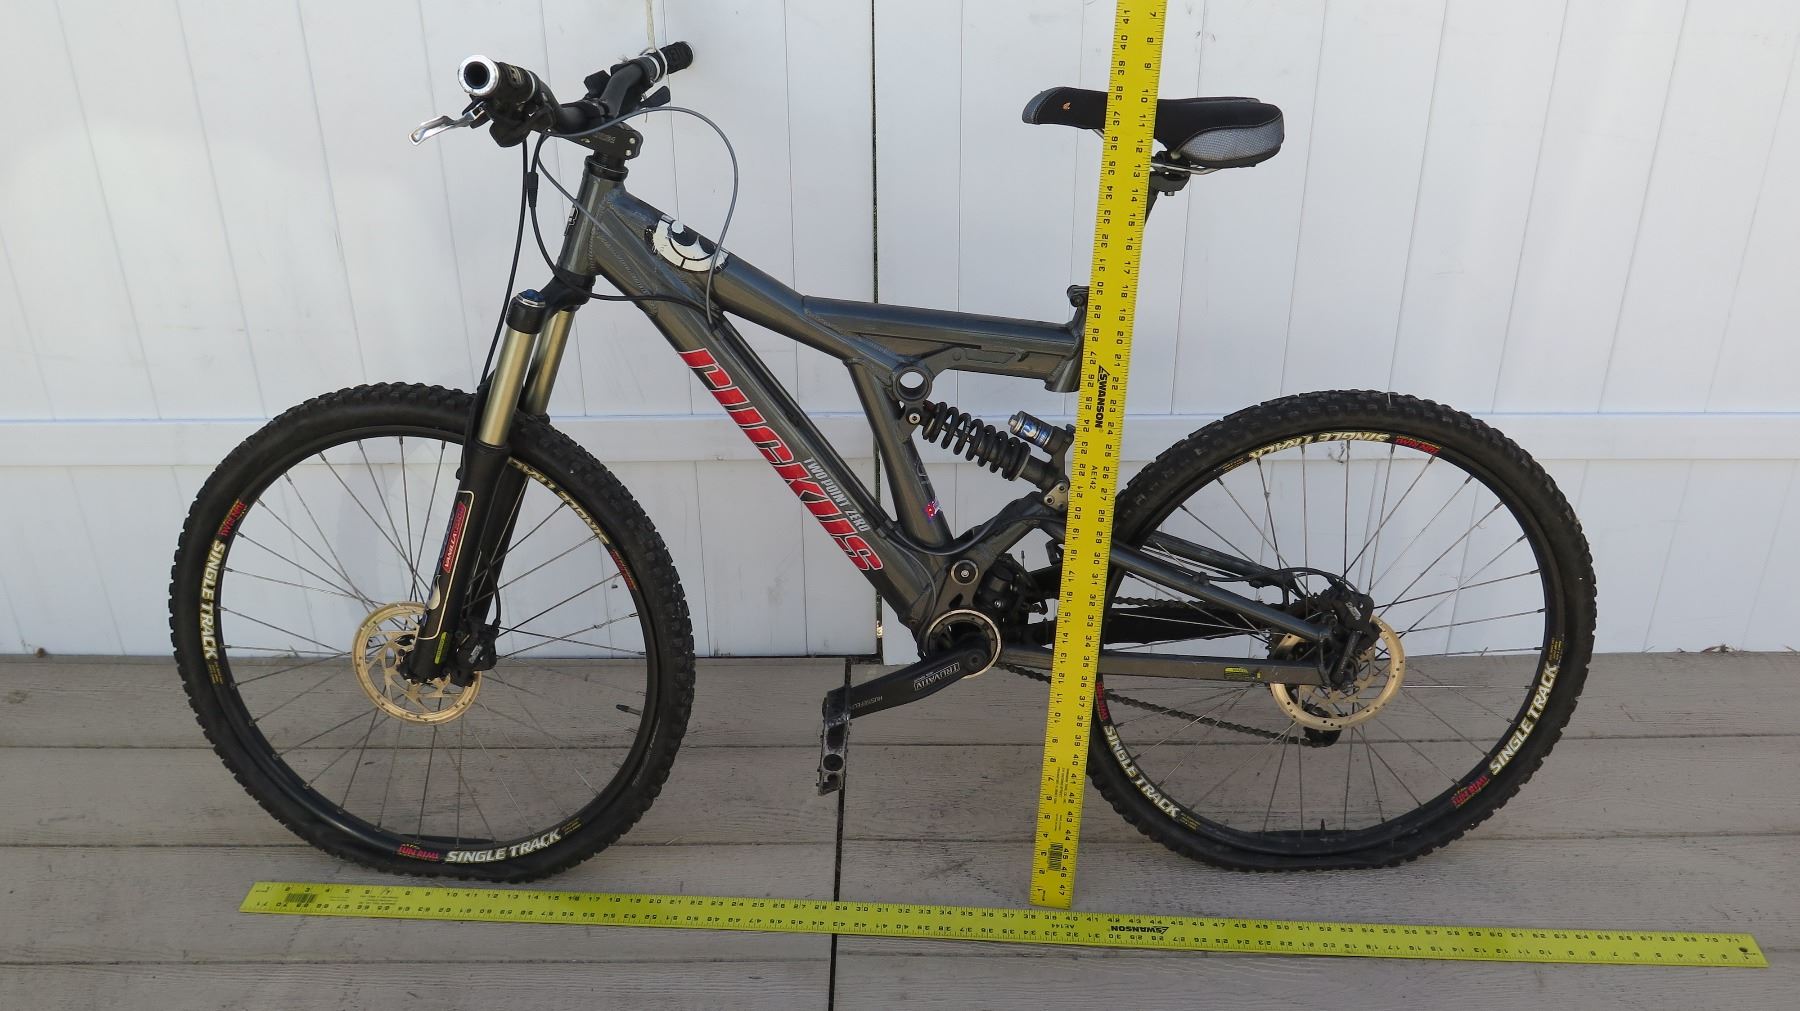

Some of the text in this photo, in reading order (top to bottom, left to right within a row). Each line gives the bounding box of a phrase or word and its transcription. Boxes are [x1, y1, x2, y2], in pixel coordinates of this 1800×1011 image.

[1123, 10, 1130, 24] 41
[1120, 35, 1128, 50] 40
[1118, 61, 1125, 75] 39
[1115, 86, 1123, 100] 38
[1141, 89, 1148, 103] 10
[1113, 111, 1120, 126] 37
[1139, 114, 1146, 127] 11
[1111, 136, 1118, 150] 36
[1136, 139, 1143, 153] 12
[1108, 161, 1116, 175] 35
[1133, 164, 1141, 177] 13
[1106, 186, 1113, 199] 34
[1131, 189, 1138, 202] 14
[1103, 210, 1111, 224] 33
[1128, 213, 1136, 226] 15
[1101, 234, 1108, 248] 32
[1126, 237, 1133, 250] 16
[1099, 259, 1106, 271] 31
[1124, 261, 1131, 274] 17
[1096, 282, 1104, 295] 30
[1121, 285, 1128, 298] 18
[1094, 305, 1101, 319] 29
[1119, 309, 1126, 321] 19
[1092, 328, 1099, 342] 28
[1116, 331, 1124, 344] 20
[1090, 351, 1096, 365] 27
[1114, 354, 1121, 366] 21
[1087, 374, 1095, 387] 26
[1112, 377, 1119, 390] 22
[1085, 397, 1092, 410] 25
[1095, 374, 1108, 428] SWANSON
[1109, 399, 1116, 412] 23
[1083, 419, 1090, 432] 24
[1107, 422, 1114, 435] 24
[1081, 441, 1088, 454] 23
[1105, 444, 1112, 457] 25
[1079, 463, 1086, 476] 22
[1102, 466, 1110, 479] 26
[1090, 465, 1098, 490] AE142
[804, 457, 871, 532] TWO POINT ZERO
[1076, 486, 1083, 498] 21
[1100, 488, 1107, 501] 27
[1074, 507, 1081, 519] 20
[1098, 510, 1105, 522] 28
[1072, 528, 1079, 540] 19
[1096, 531, 1103, 544] 29
[444, 533, 458, 568] VANILLA
[1070, 549, 1077, 561] 18
[1093, 552, 1100, 564] 30
[202, 540, 226, 600] SINGLE
[1068, 570, 1075, 582] 17
[1091, 573, 1098, 585] 31
[1066, 592, 1073, 603] 16
[1089, 594, 1096, 606] 32
[1064, 612, 1071, 623] 15
[1087, 615, 1094, 627] 33
[200, 602, 218, 660] TRACK
[1062, 633, 1068, 643] 14
[1085, 635, 1092, 647] 34
[1060, 653, 1067, 663] 13
[1083, 656, 1090, 667] 35
[914, 662, 960, 690] TRUVATIV
[1058, 673, 1065, 683] 12
[1081, 676, 1087, 687] 36
[1056, 694, 1063, 703] 11
[1079, 696, 1085, 707] 37
[1054, 712, 1061, 723] 10
[1076, 715, 1083, 727] 38
[1489, 661, 1560, 776] SINGLE TRACK
[1074, 735, 1081, 746] 39
[1104, 725, 1180, 818] SINGLE TRACK
[445, 828, 562, 864] SINGLE TRACK
[1110, 925, 1164, 933] SWANSON
